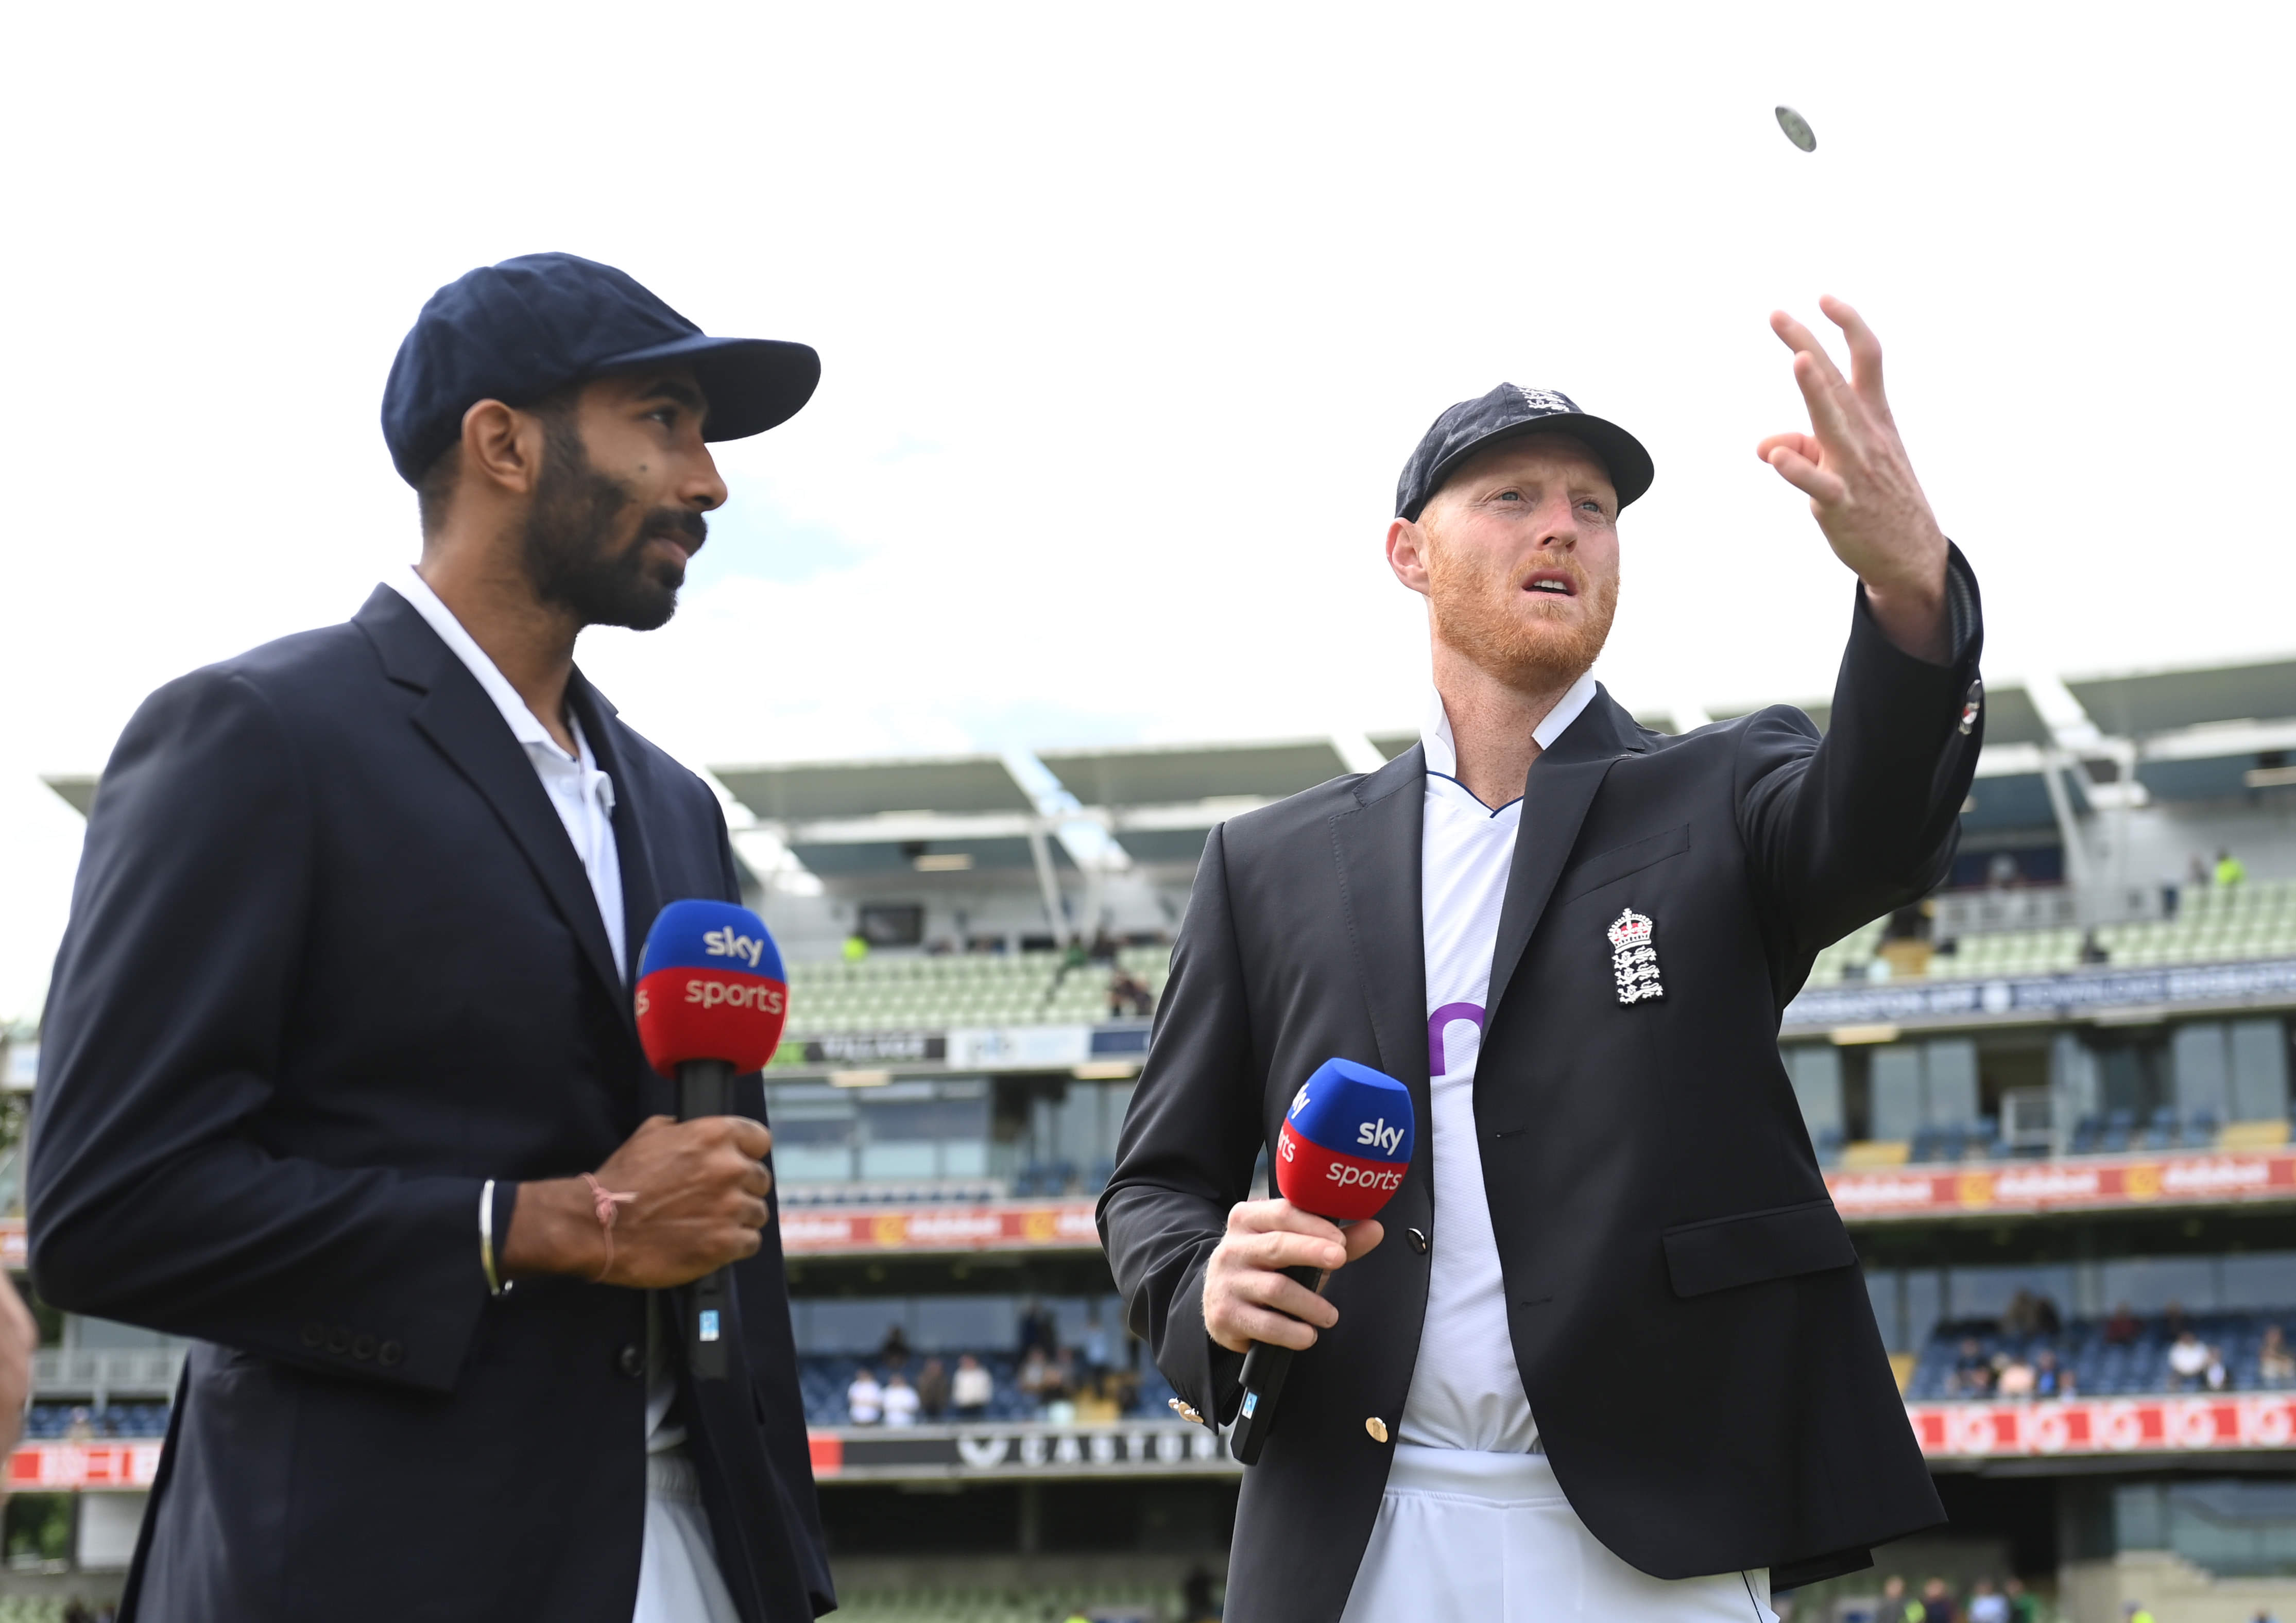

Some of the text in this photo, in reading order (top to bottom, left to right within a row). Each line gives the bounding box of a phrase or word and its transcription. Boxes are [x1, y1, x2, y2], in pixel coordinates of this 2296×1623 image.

[702, 925, 764, 968] sky
[684, 979, 783, 1015] sports
[1357, 1118, 1405, 1155] sky
[1326, 1162, 1402, 1190] sports
[1022, 1432, 1232, 1464] CASTOR
